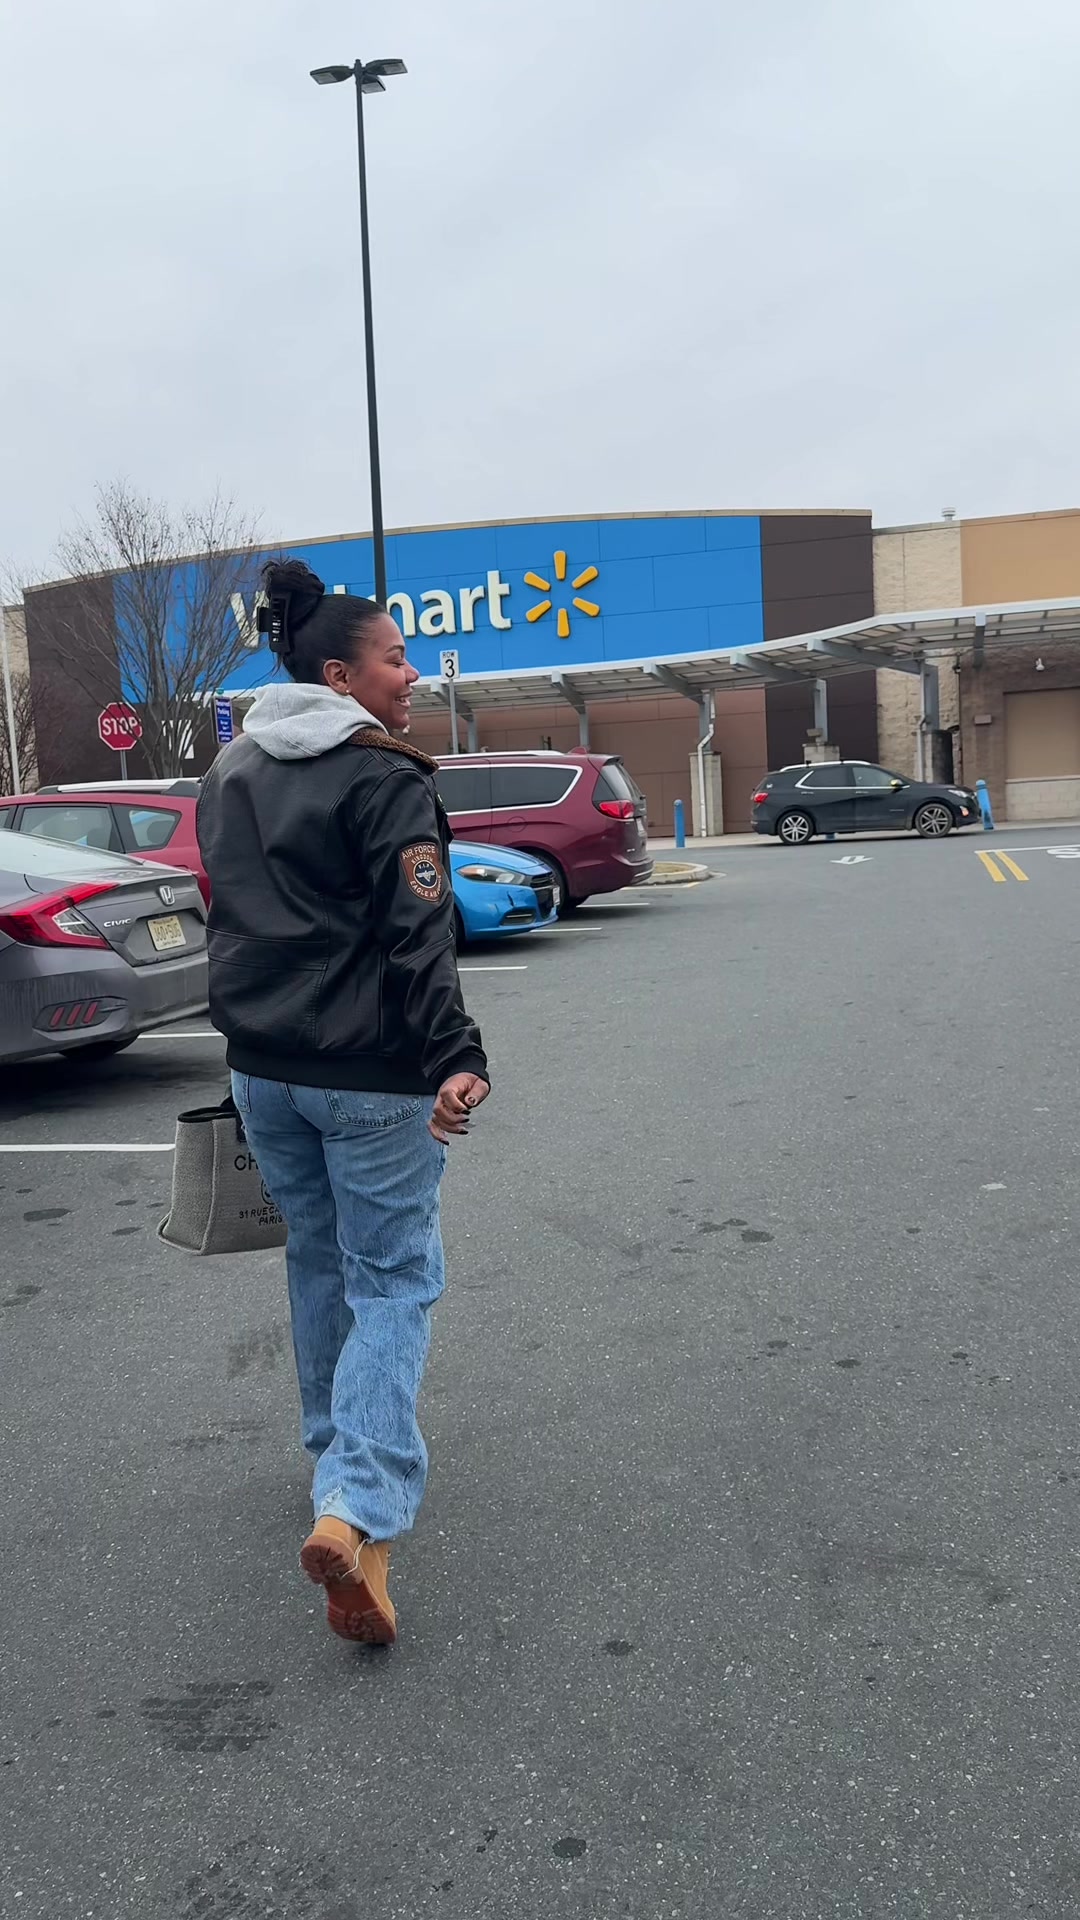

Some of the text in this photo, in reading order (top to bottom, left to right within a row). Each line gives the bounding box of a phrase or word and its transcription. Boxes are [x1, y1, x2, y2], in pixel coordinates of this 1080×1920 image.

[445, 658, 455, 678] 3
[102, 716, 138, 736] STOP
[402, 845, 436, 860] AIR FORCE
[410, 881, 428, 897] EAGLE
[103, 918, 131, 927] CIVIC
[239, 1210, 249, 1219] 31
[250, 1207, 268, 1218] RUE
[259, 1214, 283, 1226] PARIS
